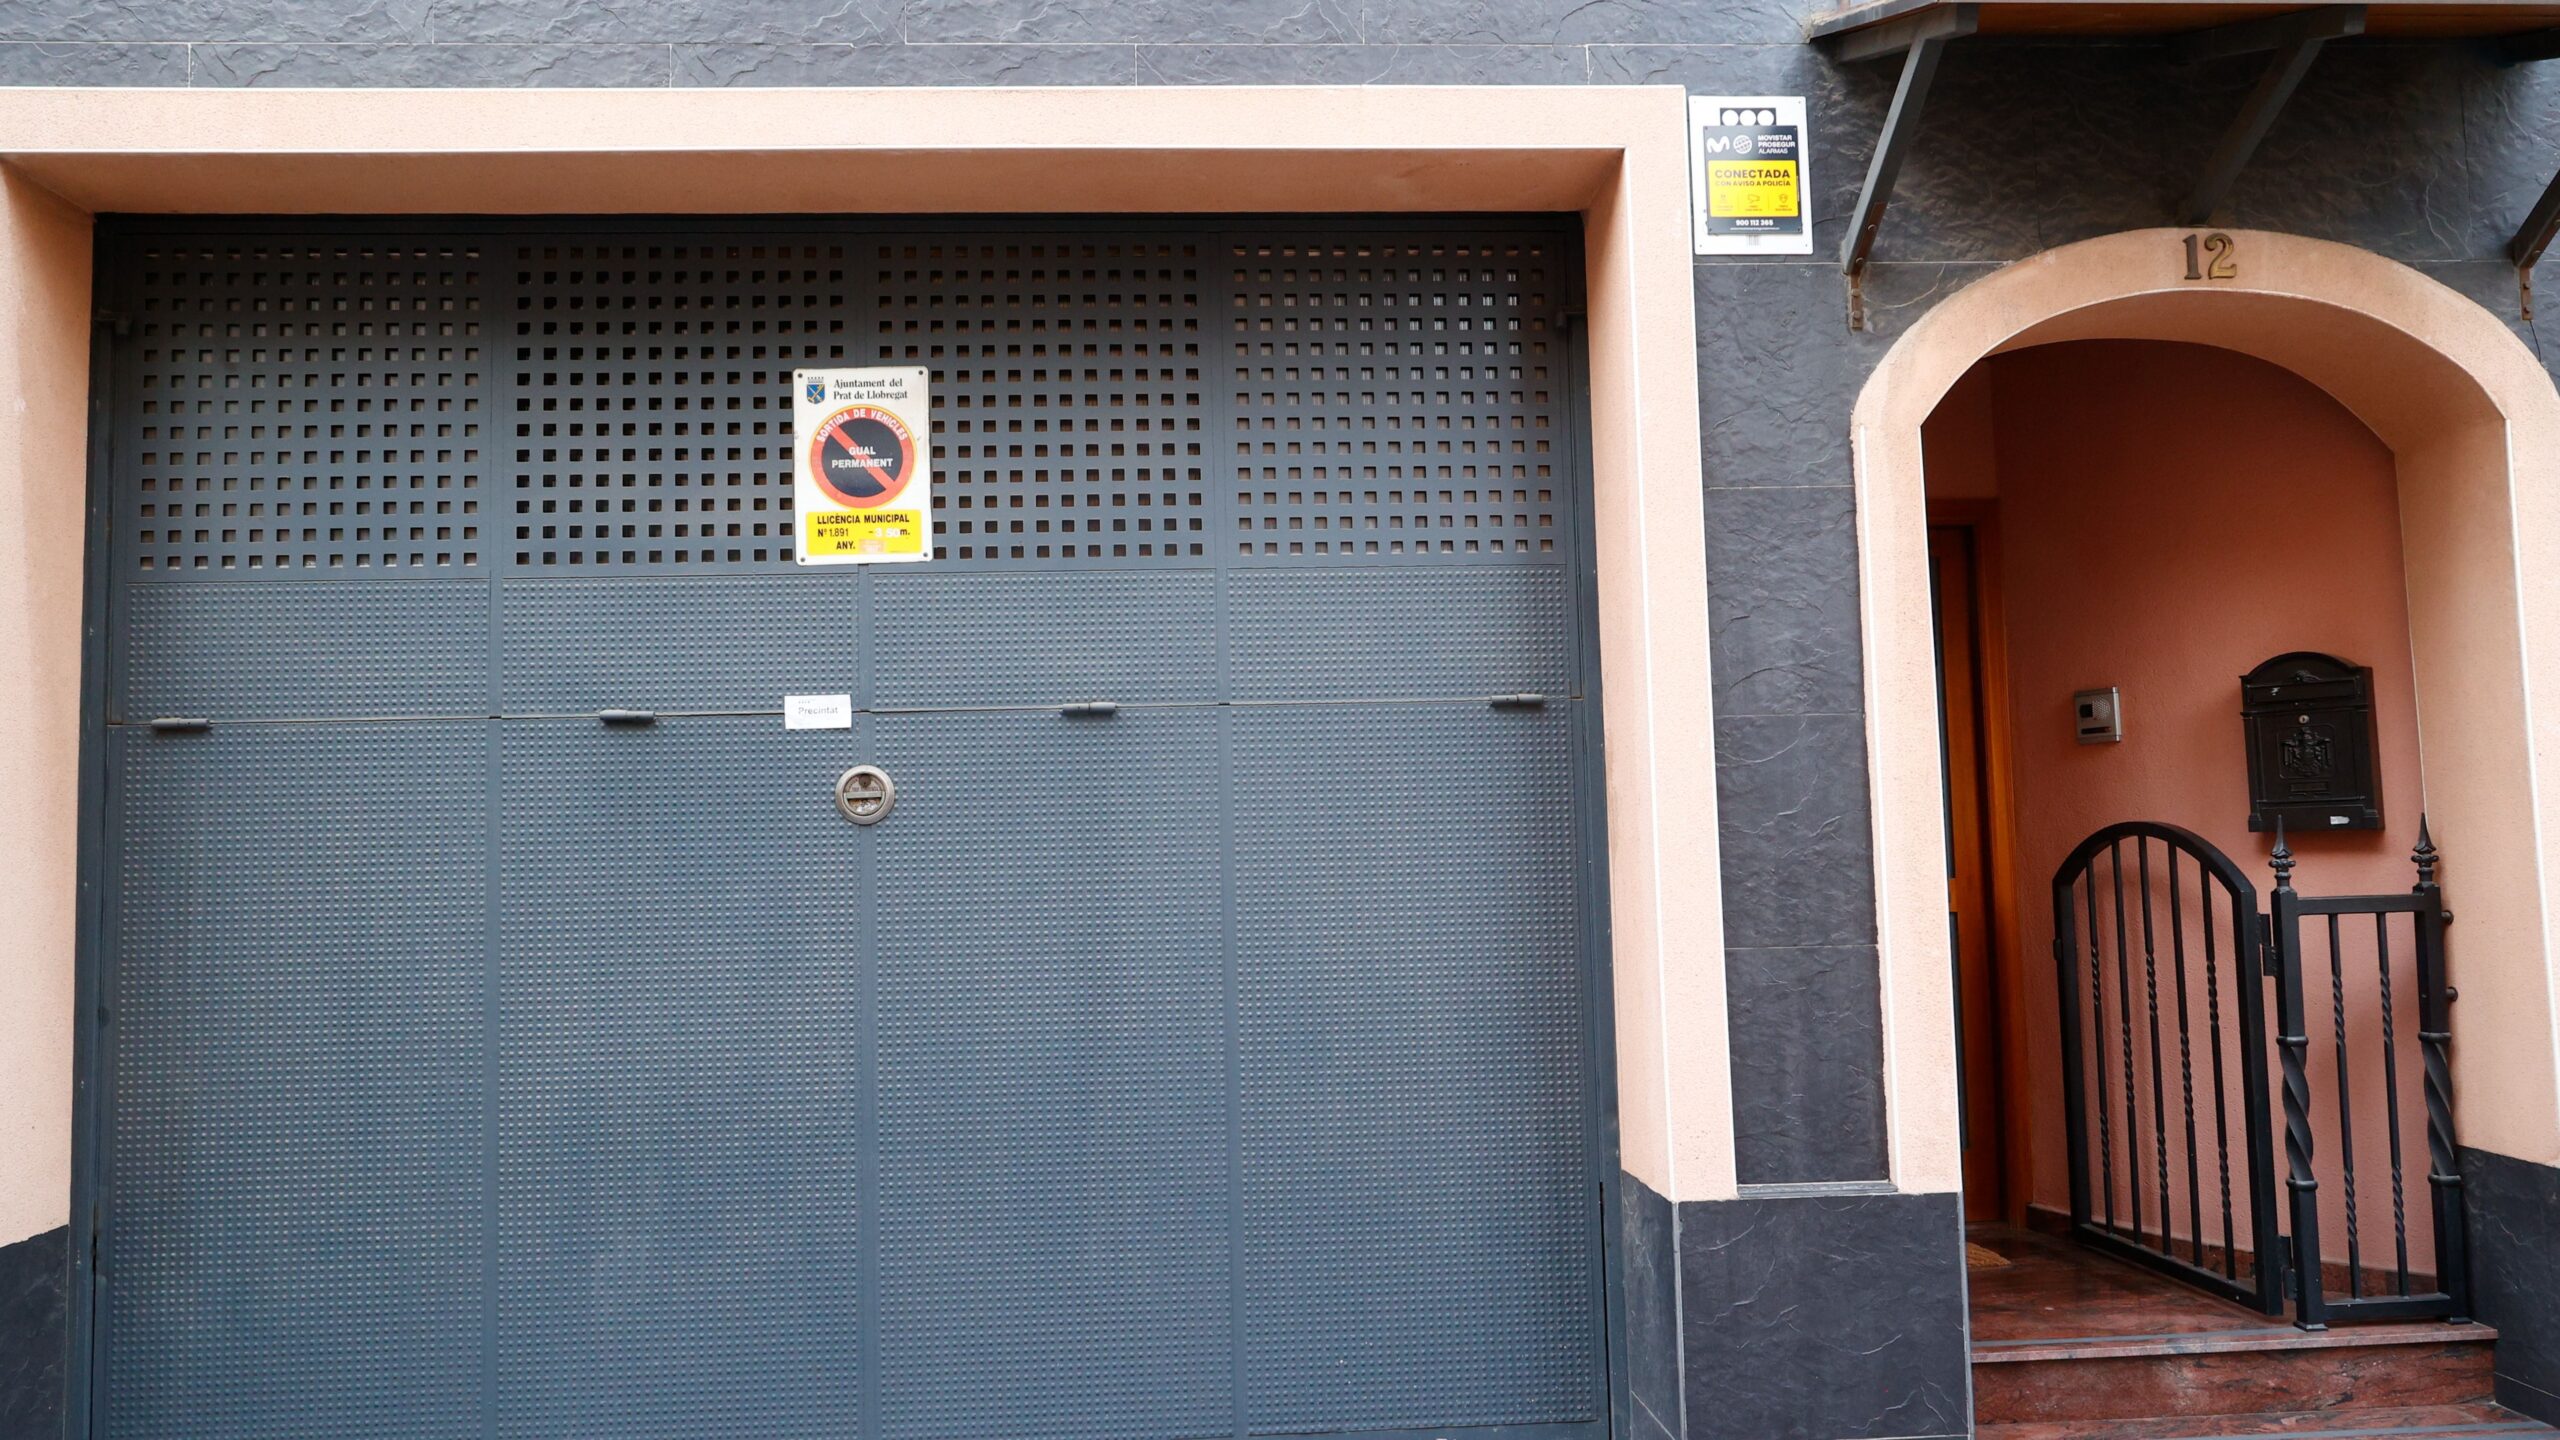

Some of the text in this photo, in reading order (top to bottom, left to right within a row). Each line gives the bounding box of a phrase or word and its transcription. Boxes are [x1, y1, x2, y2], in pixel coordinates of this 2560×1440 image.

[1715, 169, 1790, 178] CONECTADA
[2182, 232, 2238, 280] 12
[834, 378, 903, 388] Ajuntament del
[833, 390, 908, 401] Prat de Llobregat
[816, 408, 908, 442] SORTIDA DE VEHICLES
[848, 446, 876, 455] GUAL
[831, 458, 893, 469] PERMANENT
[864, 514, 910, 523] MUNICIPAL
[836, 541, 855, 550] ANY.
[798, 707, 839, 715] Precintat
